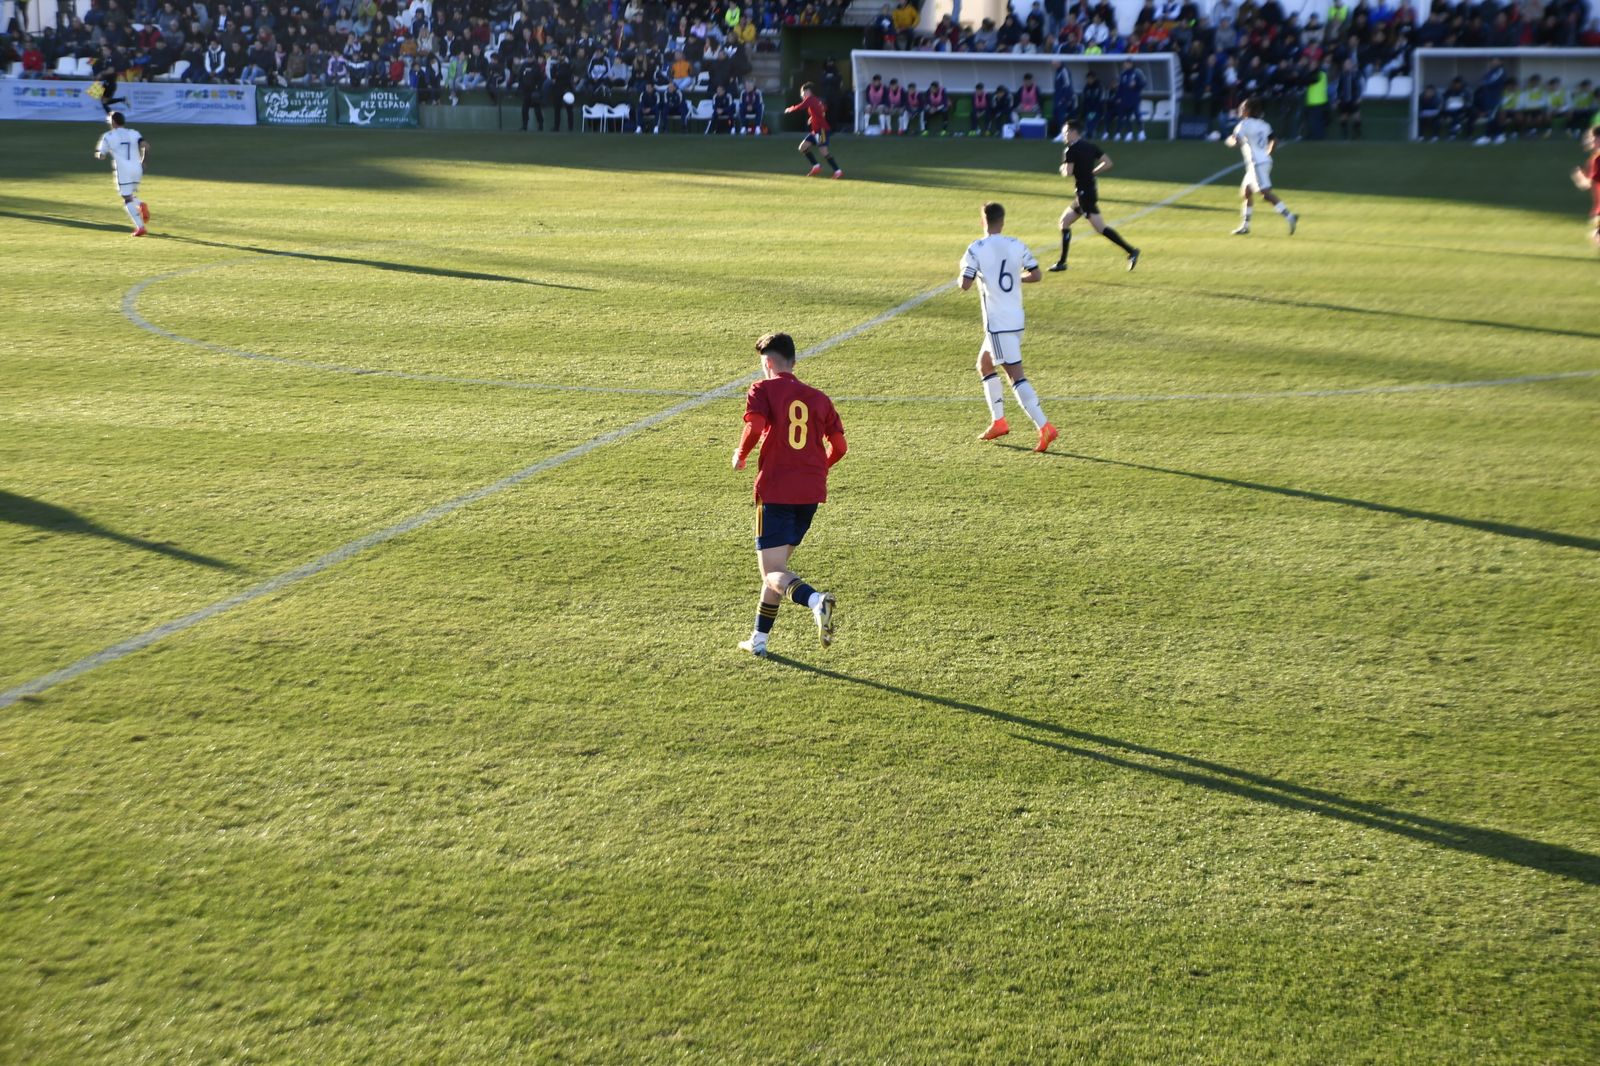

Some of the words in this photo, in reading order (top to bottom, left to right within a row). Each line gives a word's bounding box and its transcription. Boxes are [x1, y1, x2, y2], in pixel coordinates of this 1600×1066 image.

[360, 101, 376, 109] PEZ
[378, 101, 410, 109] ESPADA
[370, 92, 399, 100] HOTEL
[120, 142, 131, 160] 7
[998, 259, 1013, 293] 6
[788, 399, 809, 450] 8
